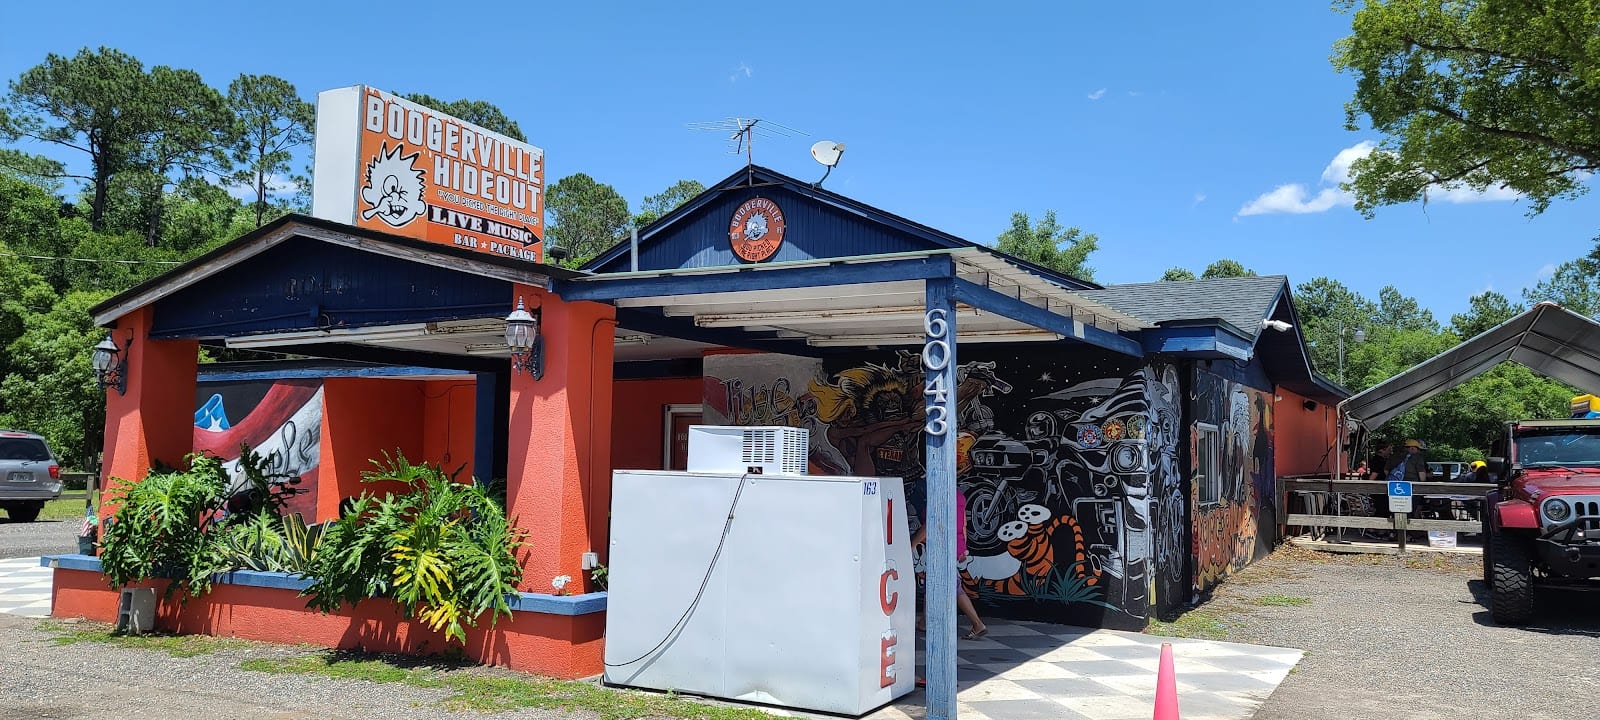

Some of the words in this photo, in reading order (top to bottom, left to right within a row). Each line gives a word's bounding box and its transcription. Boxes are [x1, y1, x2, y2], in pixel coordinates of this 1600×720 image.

[366, 94, 542, 184] BOOGERVILLE
[434, 154, 541, 214] HIDEOUT
[432, 205, 483, 233] LIVE
[487, 220, 532, 243] MUSIC
[486, 203, 498, 216] THE
[732, 199, 782, 227] BOOGERVILLE
[453, 233, 478, 248] BAR
[489, 241, 537, 263] PACKAGE
[922, 308, 951, 436] 6043
[863, 481, 877, 496] 163
[879, 489, 899, 689] ICE
